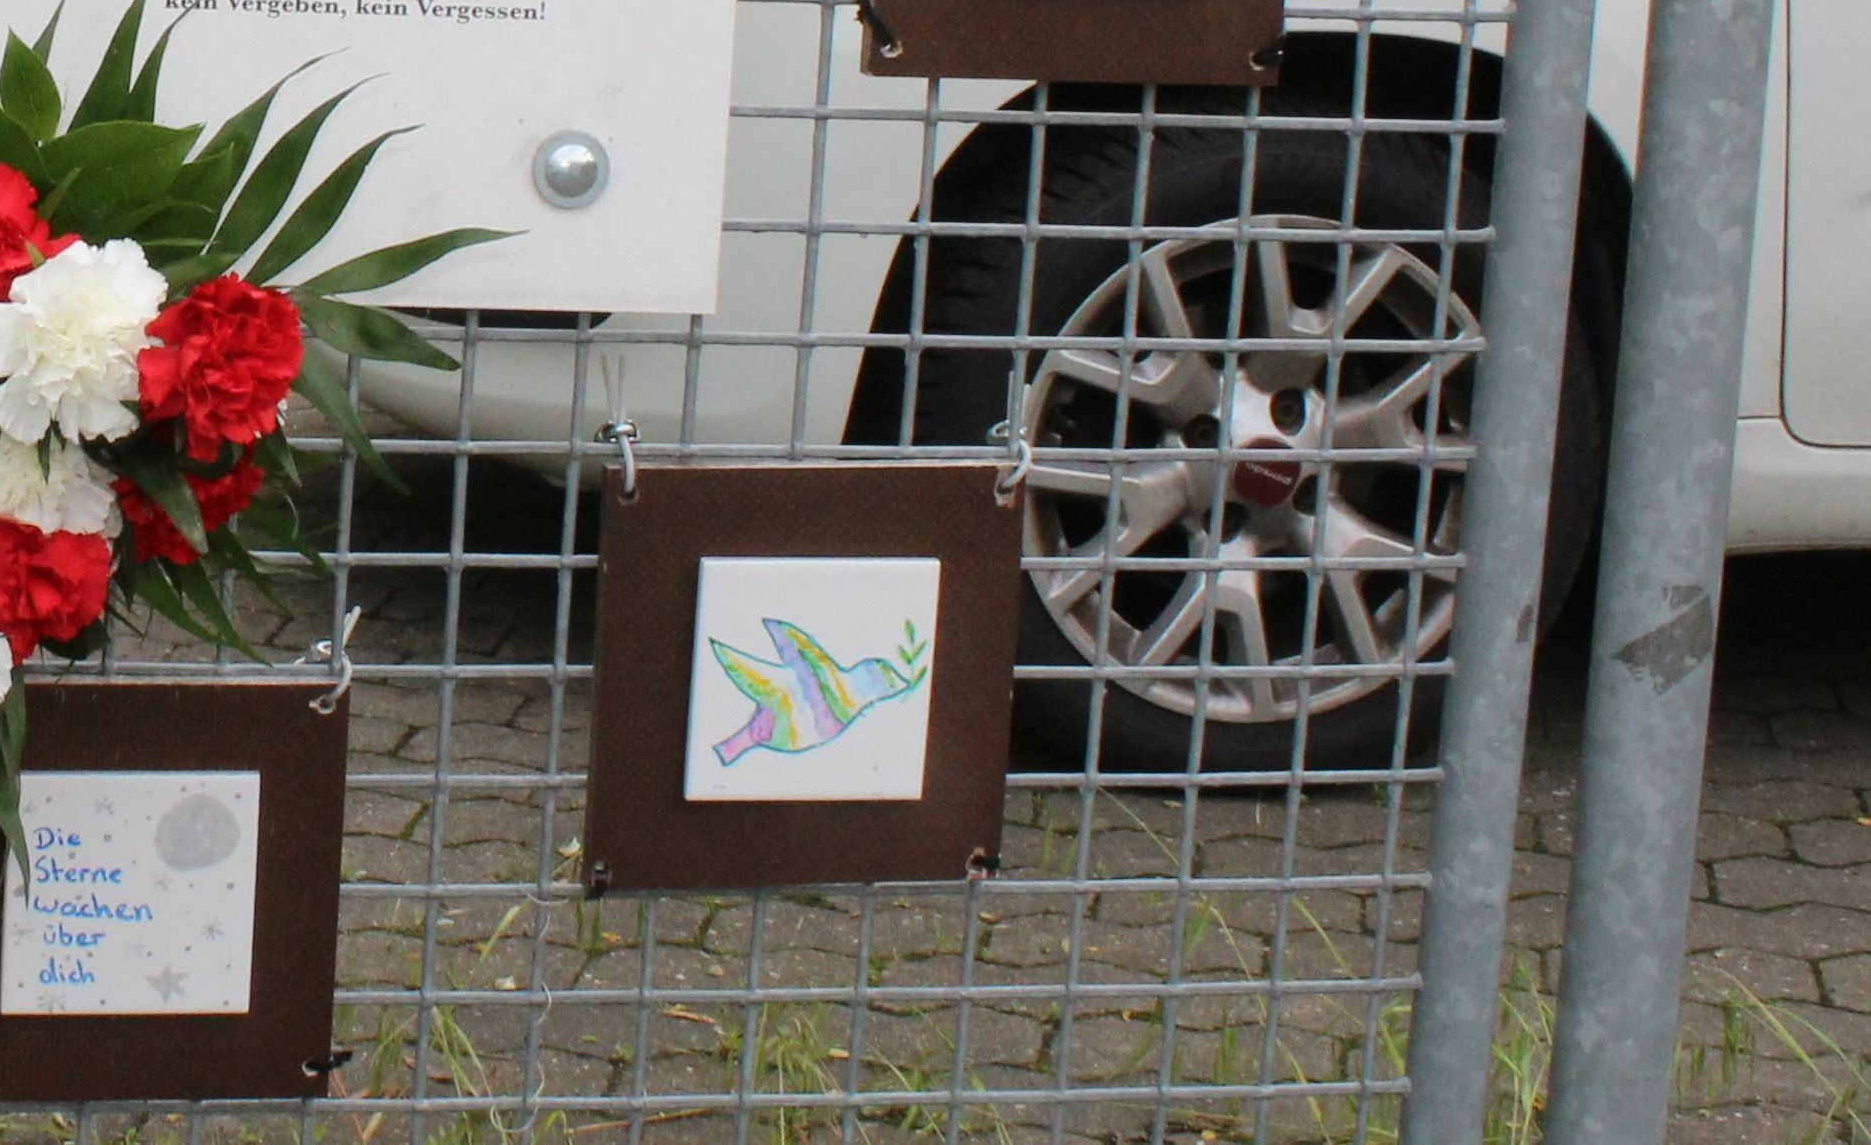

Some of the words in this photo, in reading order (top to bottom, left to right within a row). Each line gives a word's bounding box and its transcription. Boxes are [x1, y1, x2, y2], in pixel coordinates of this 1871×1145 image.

[33, 827, 81, 850] Die
[34, 855, 123, 884] Sterne
[42, 922, 106, 947] über
[38, 956, 96, 985] dich
